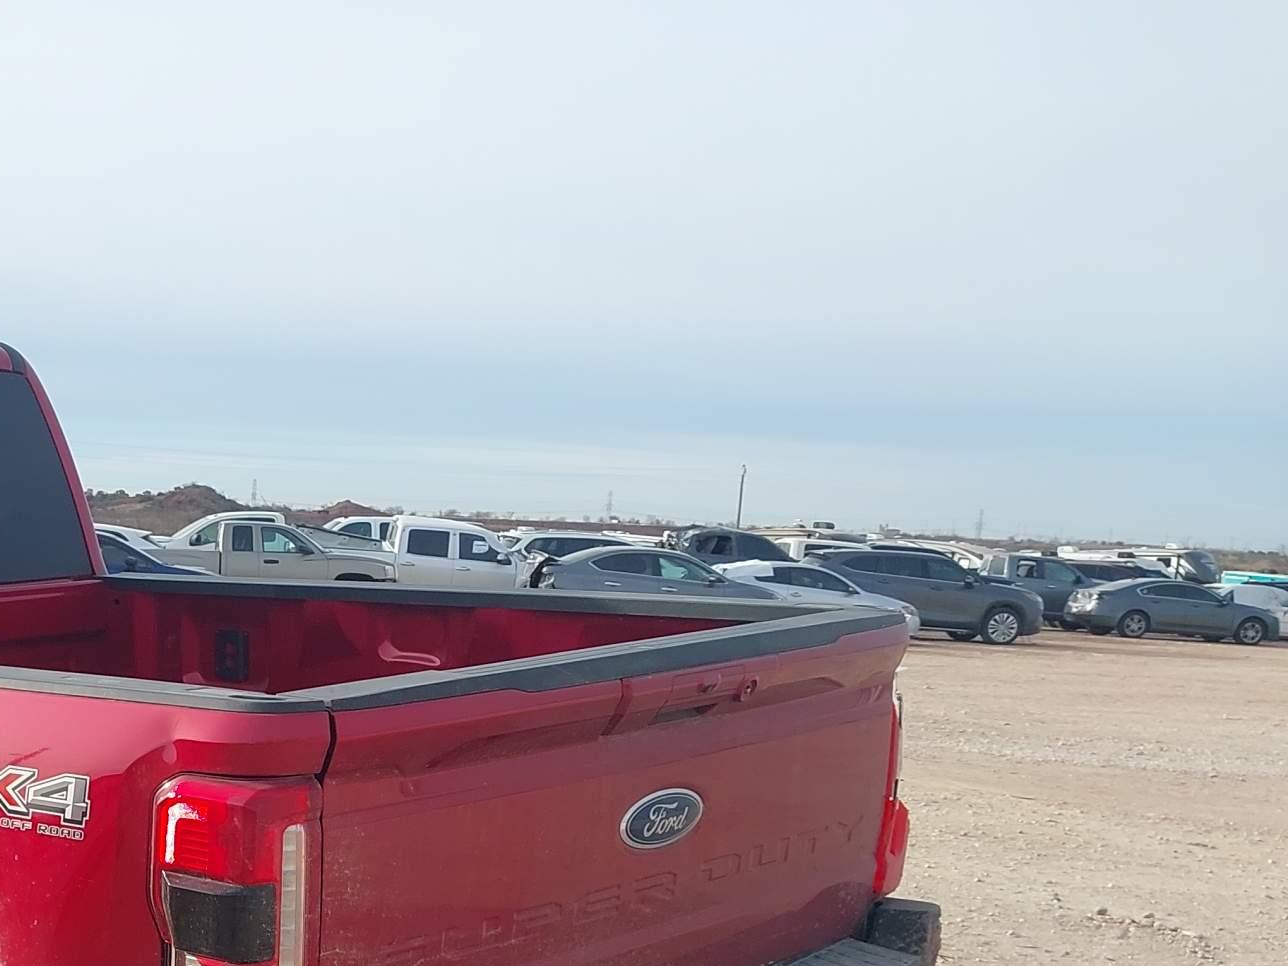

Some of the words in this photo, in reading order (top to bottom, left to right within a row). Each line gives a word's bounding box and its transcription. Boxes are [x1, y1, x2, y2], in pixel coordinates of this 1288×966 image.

[0, 817, 33, 832] OFF
[37, 823, 85, 841] ROAD
[643, 802, 689, 838] Ford
[700, 815, 865, 882] DUTY
